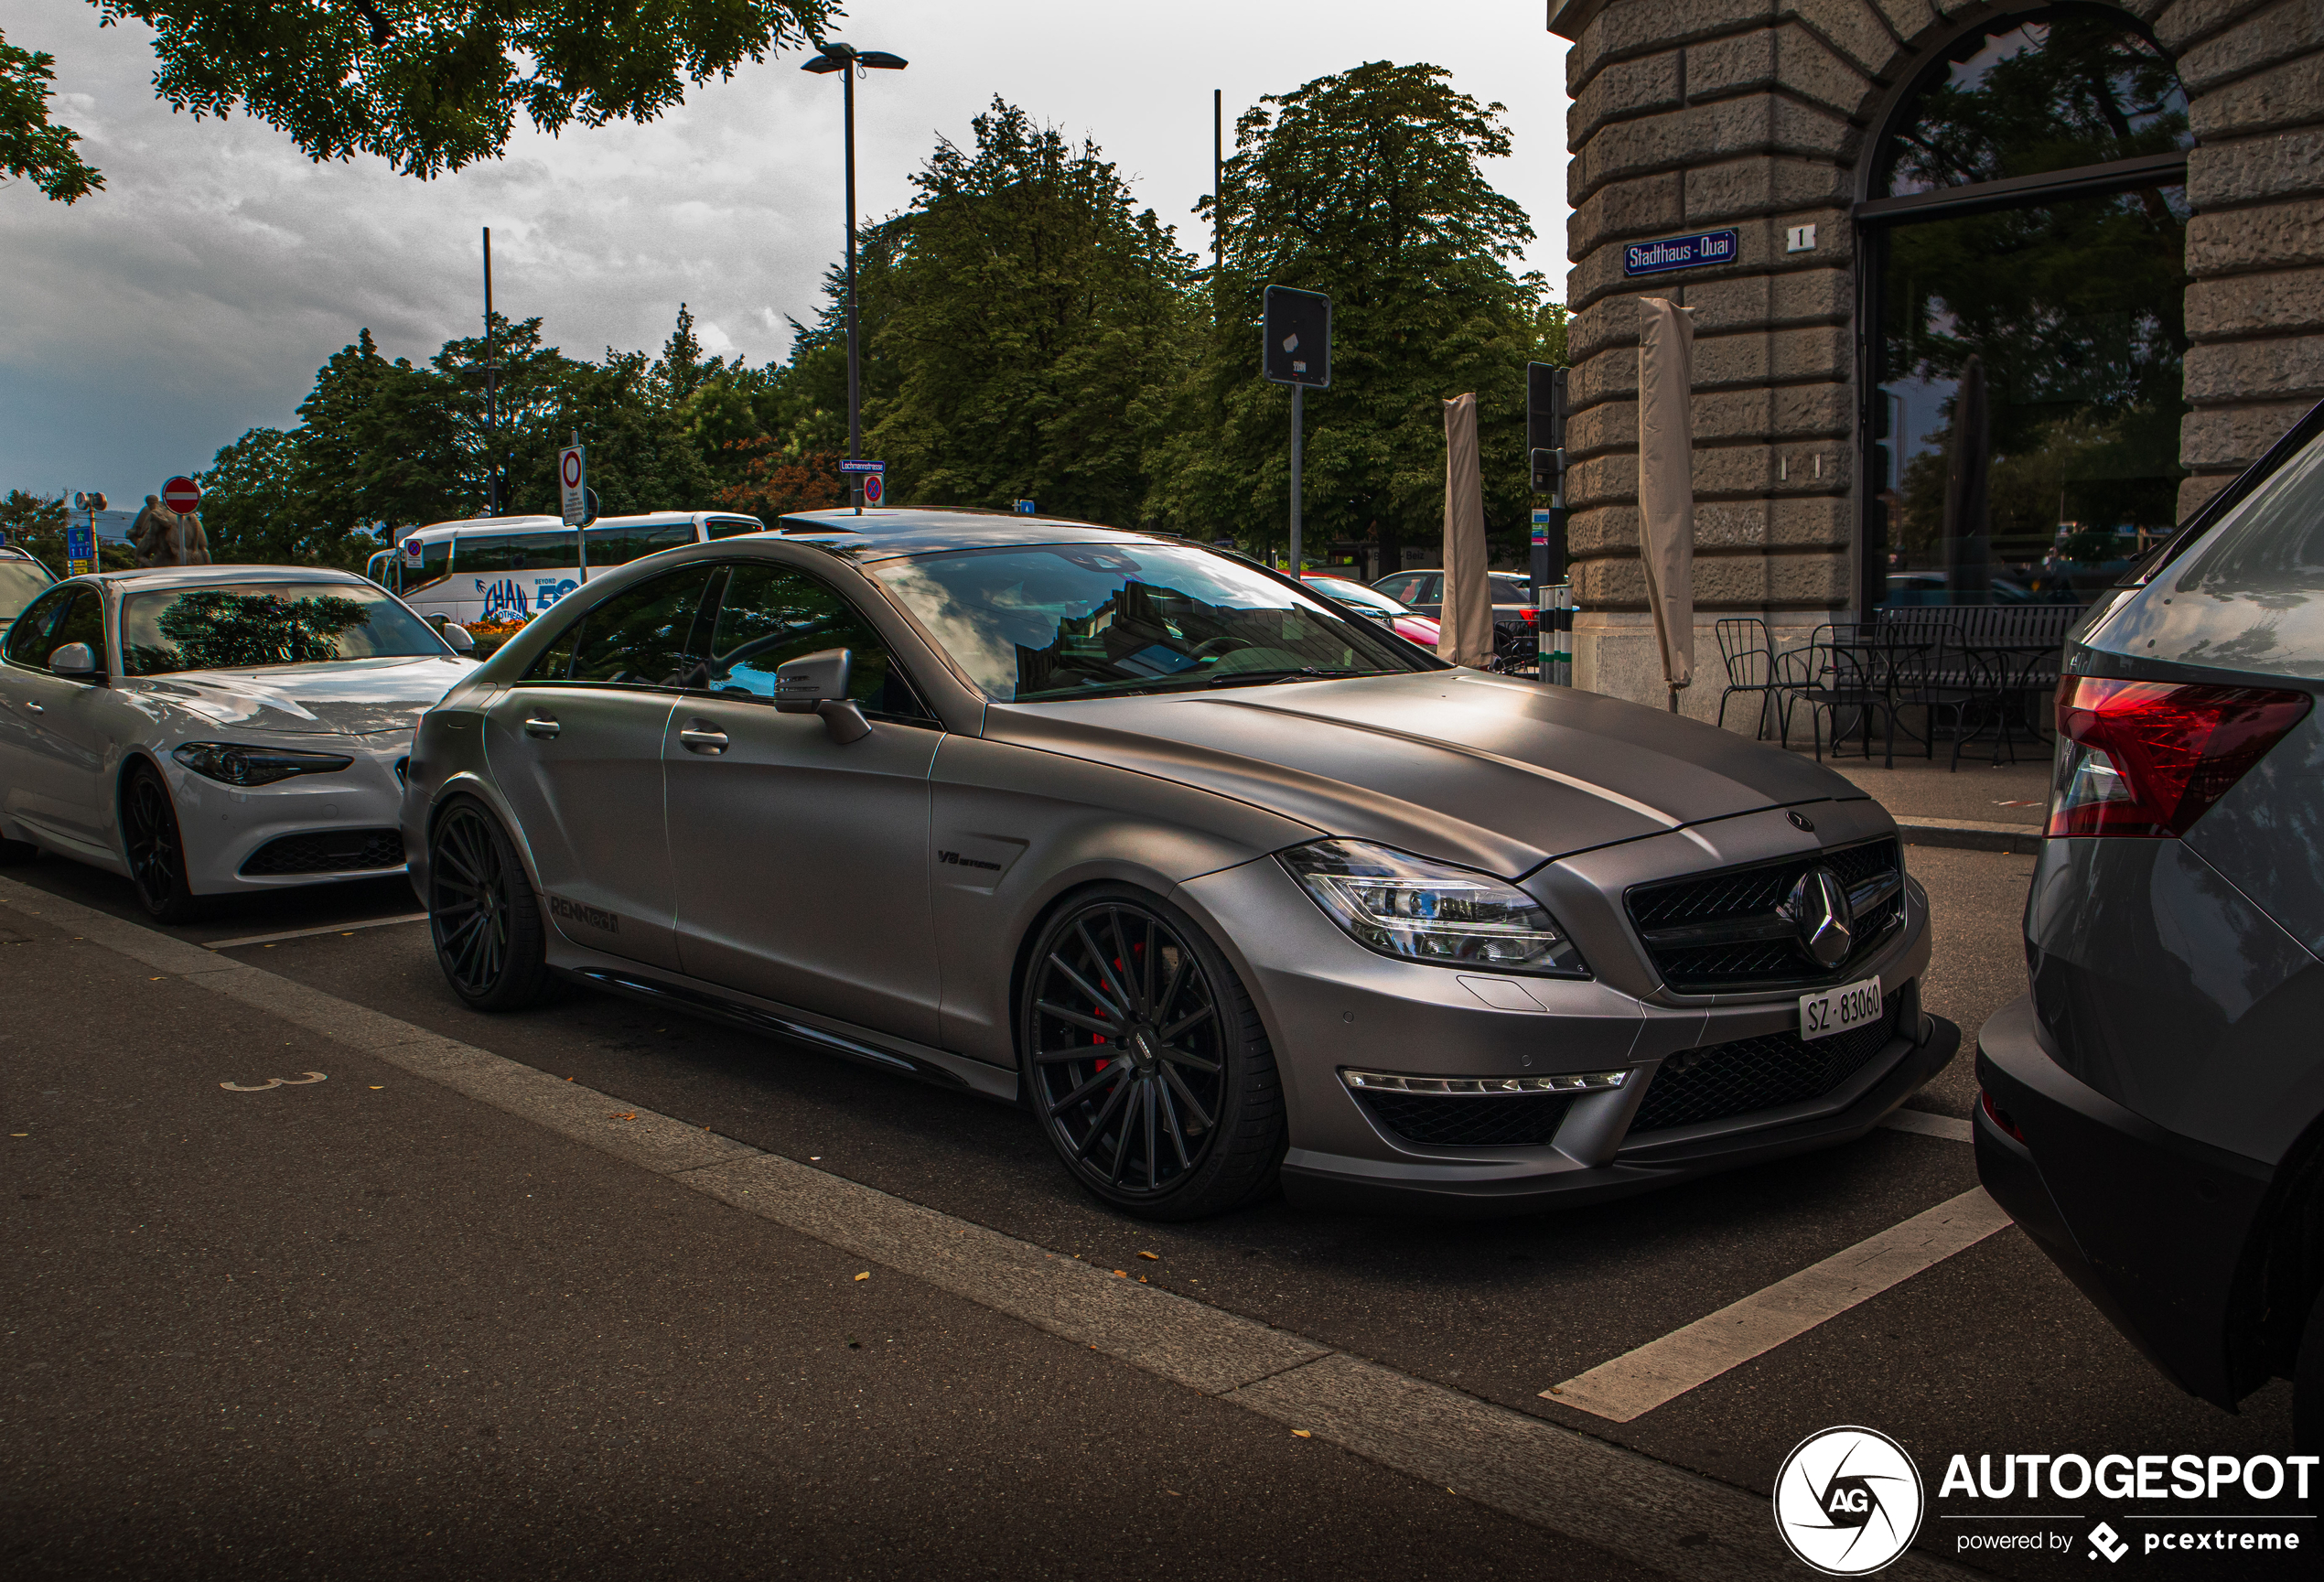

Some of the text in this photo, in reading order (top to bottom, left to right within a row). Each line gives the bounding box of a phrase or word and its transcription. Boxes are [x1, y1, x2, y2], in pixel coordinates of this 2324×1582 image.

[1798, 228, 1803, 246] 1
[484, 578, 528, 618] CHAN
[938, 850, 960, 865] V8
[1808, 997, 1830, 1032] SZ
[1840, 984, 1879, 1024] 83060
